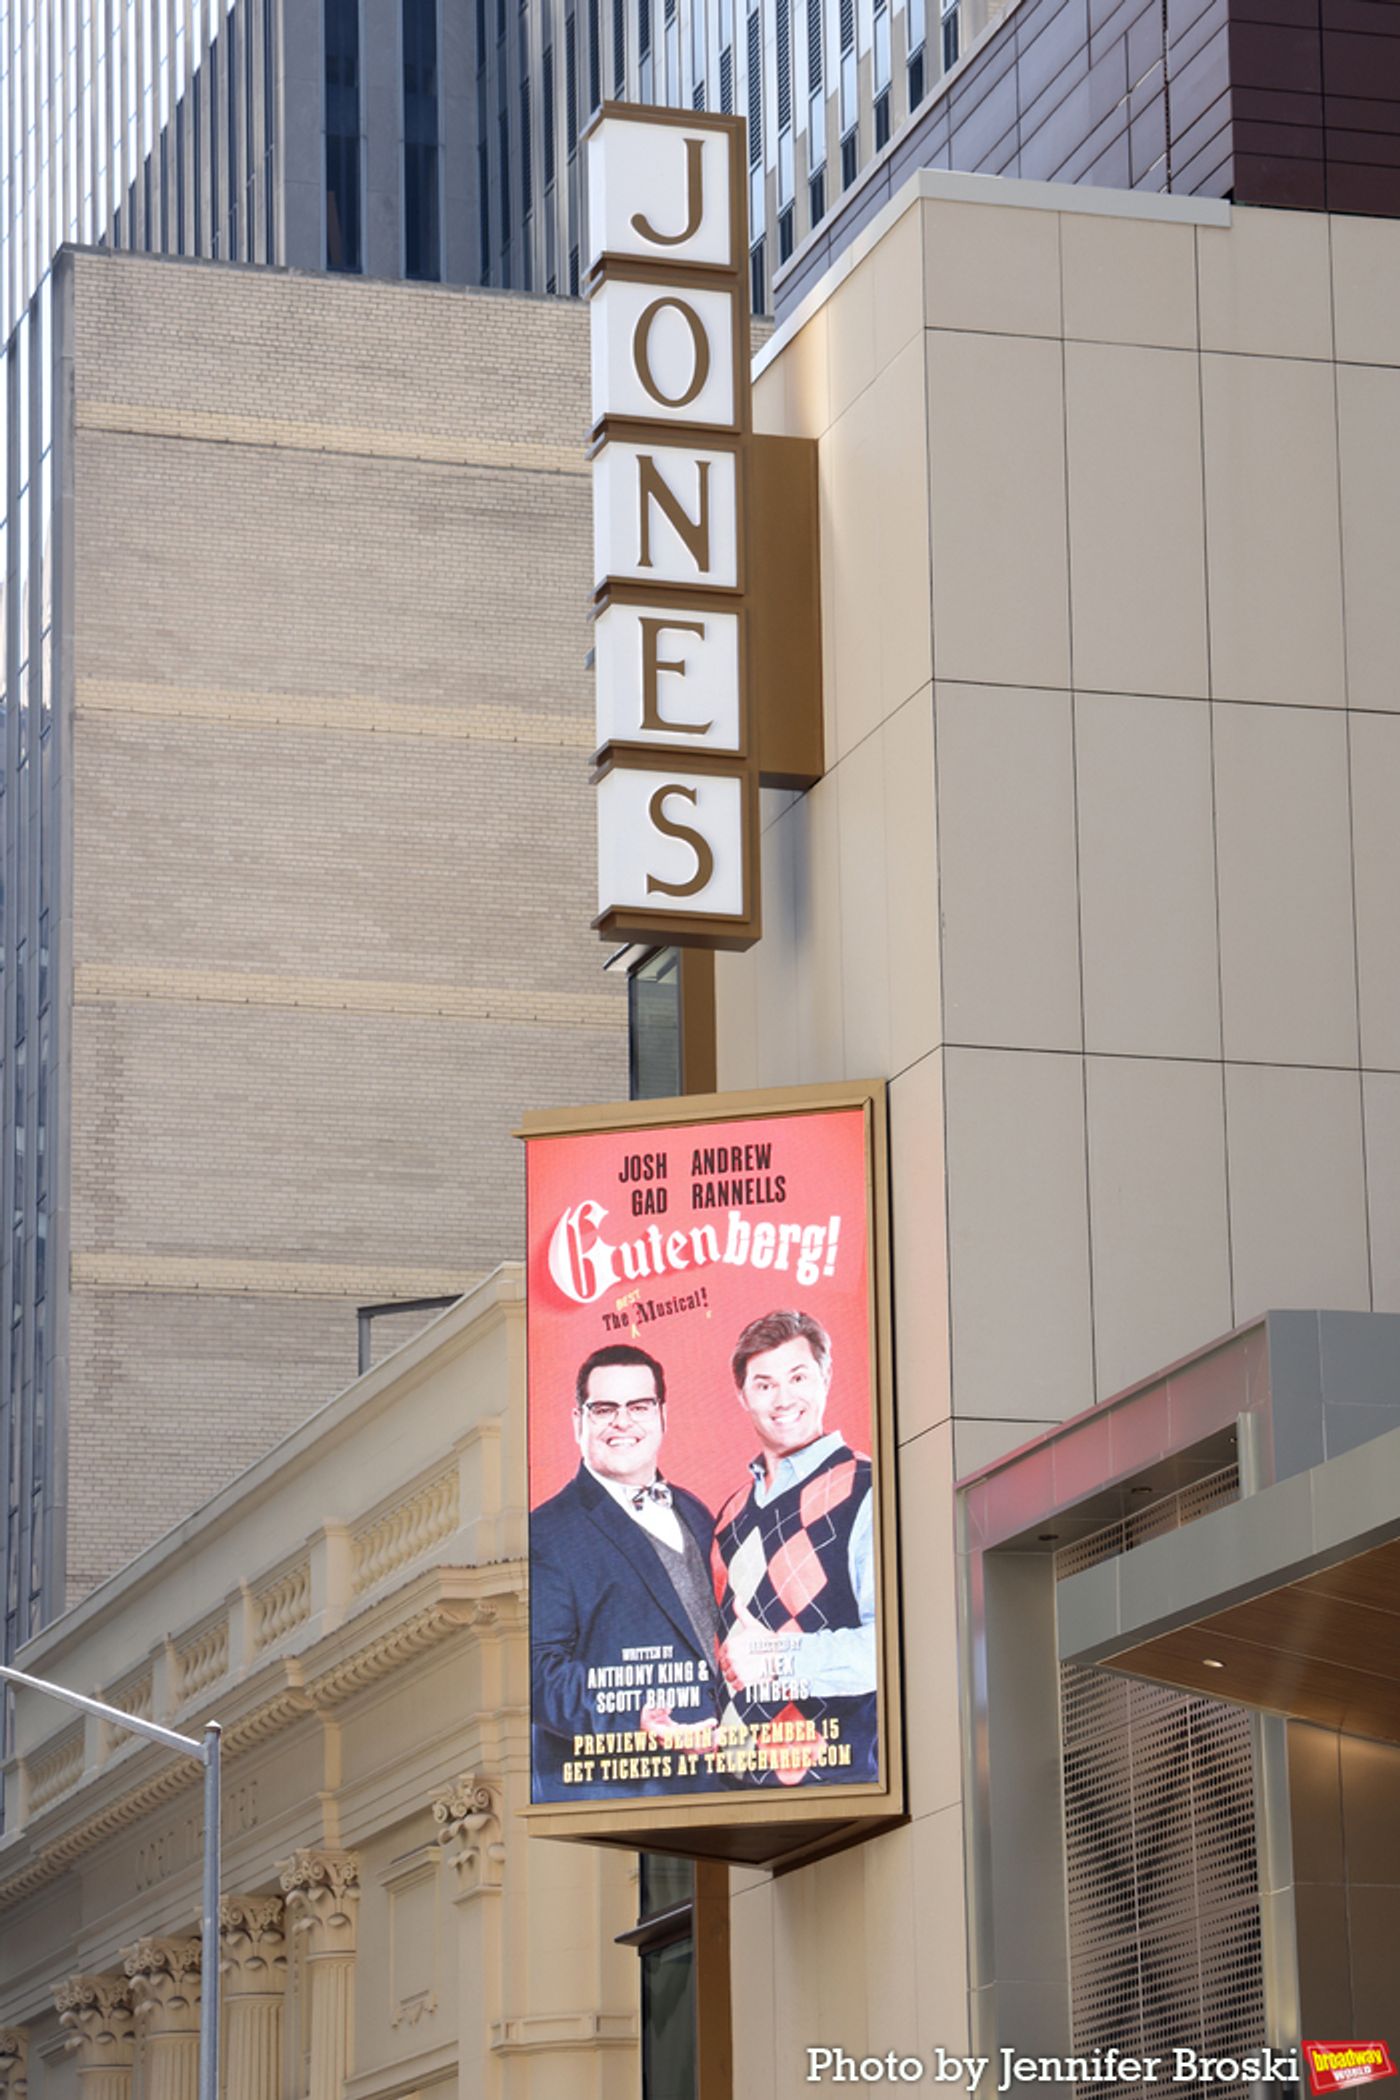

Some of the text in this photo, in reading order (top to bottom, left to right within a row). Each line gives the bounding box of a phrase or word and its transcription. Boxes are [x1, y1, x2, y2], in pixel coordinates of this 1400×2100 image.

[629, 137, 717, 899] JONES
[618, 1152, 668, 1183] JOSH
[691, 1142, 773, 1177] ANDREW
[631, 1187, 668, 1217] GAD
[692, 1175, 787, 1210] RANNELLS
[548, 1199, 842, 1304] Gutenberg!
[602, 1286, 709, 1331] The Musical!
[587, 1659, 710, 1690] ANTHONY KING &
[743, 1679, 811, 1704] TIMBERS
[596, 1685, 700, 1714] SCOTT BROWN
[573, 1729, 658, 1756] PREVIEWS
[719, 1719, 816, 1747] SEPTEMBER
[821, 1717, 840, 1740] 15
[562, 1743, 852, 1784] GET TICKETS AT TELECHARGE.COM
